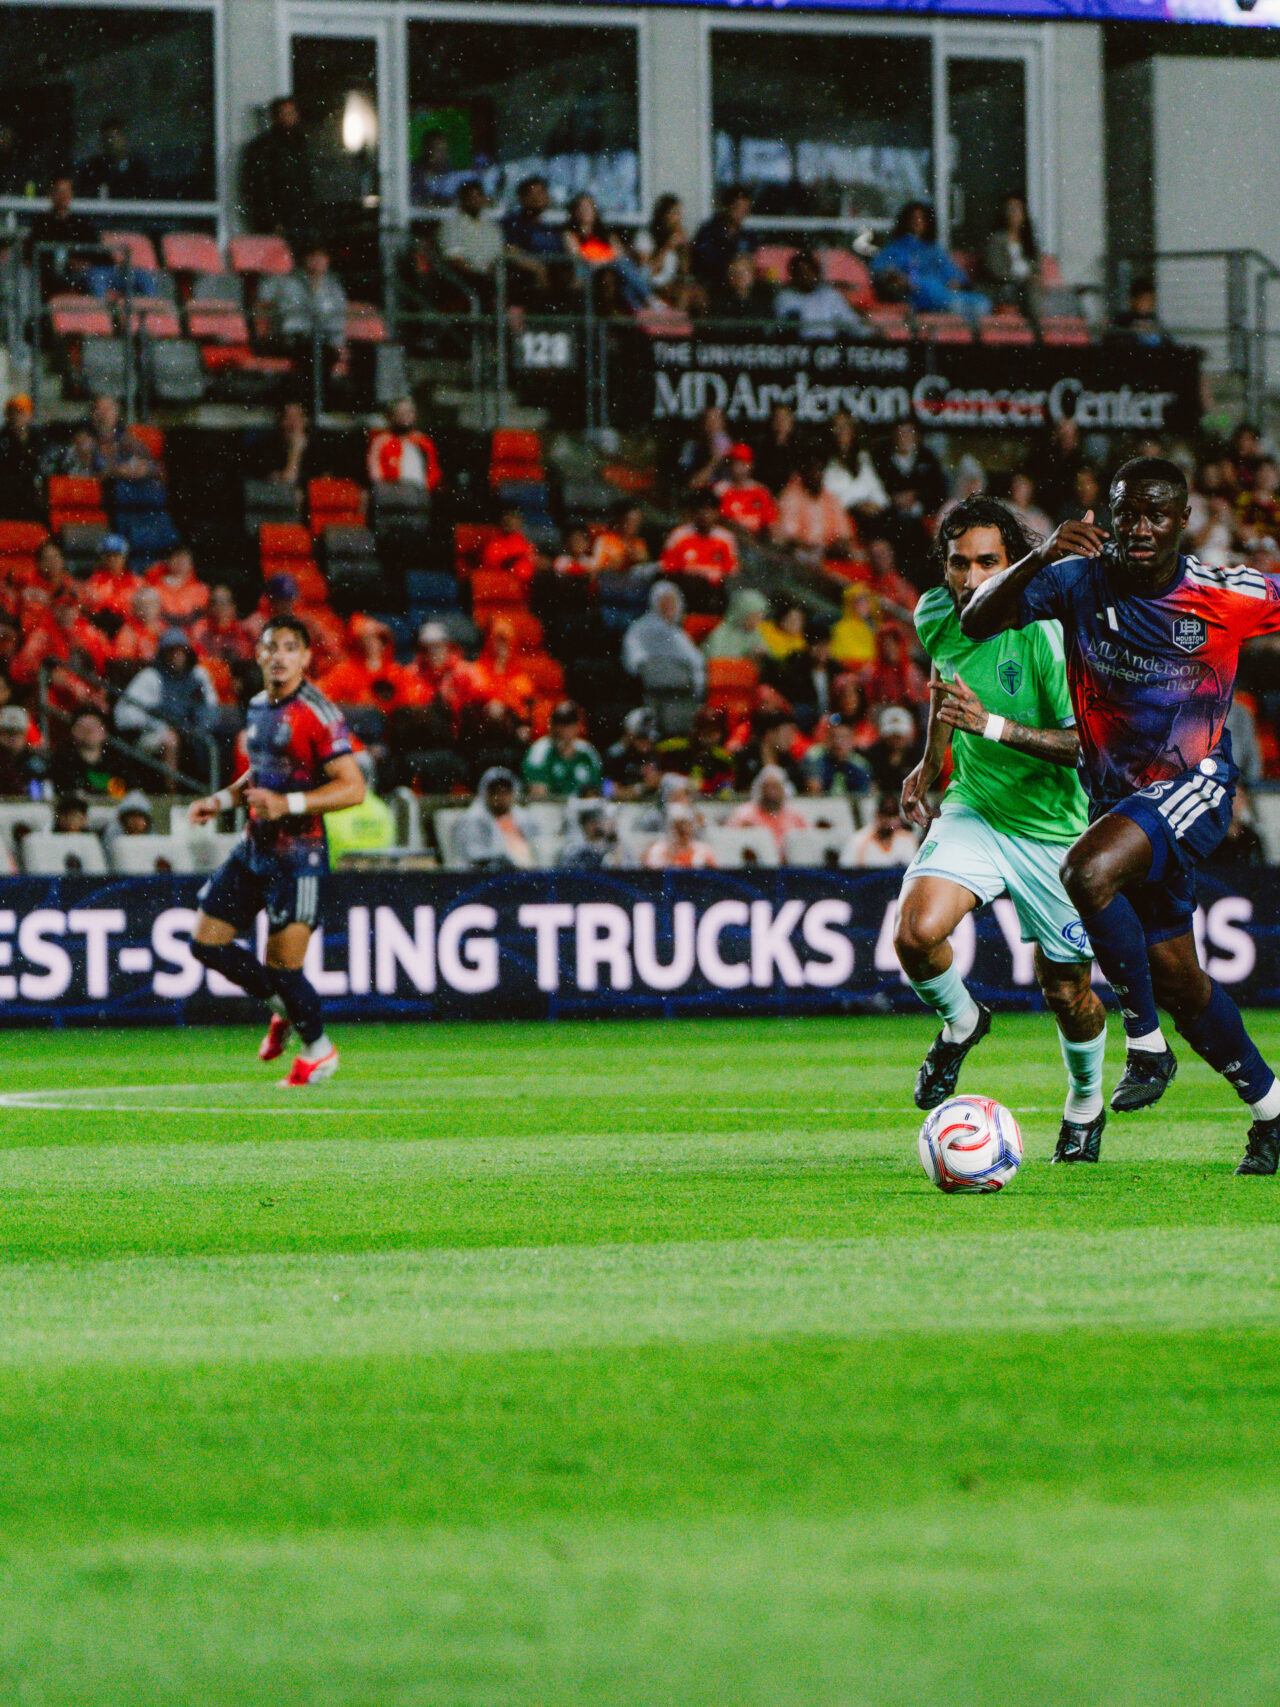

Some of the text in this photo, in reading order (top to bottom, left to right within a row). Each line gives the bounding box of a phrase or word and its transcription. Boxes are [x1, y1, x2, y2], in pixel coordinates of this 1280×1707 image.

[654, 342, 908, 371] THE UNIVERSITY OF TEXAS
[914, 376, 1046, 427] Cancer
[1049, 378, 1177, 428] Center
[1085, 653, 1144, 683] Cancer
[1119, 649, 1200, 677] Anderson
[517, 899, 854, 992] TRUCKS
